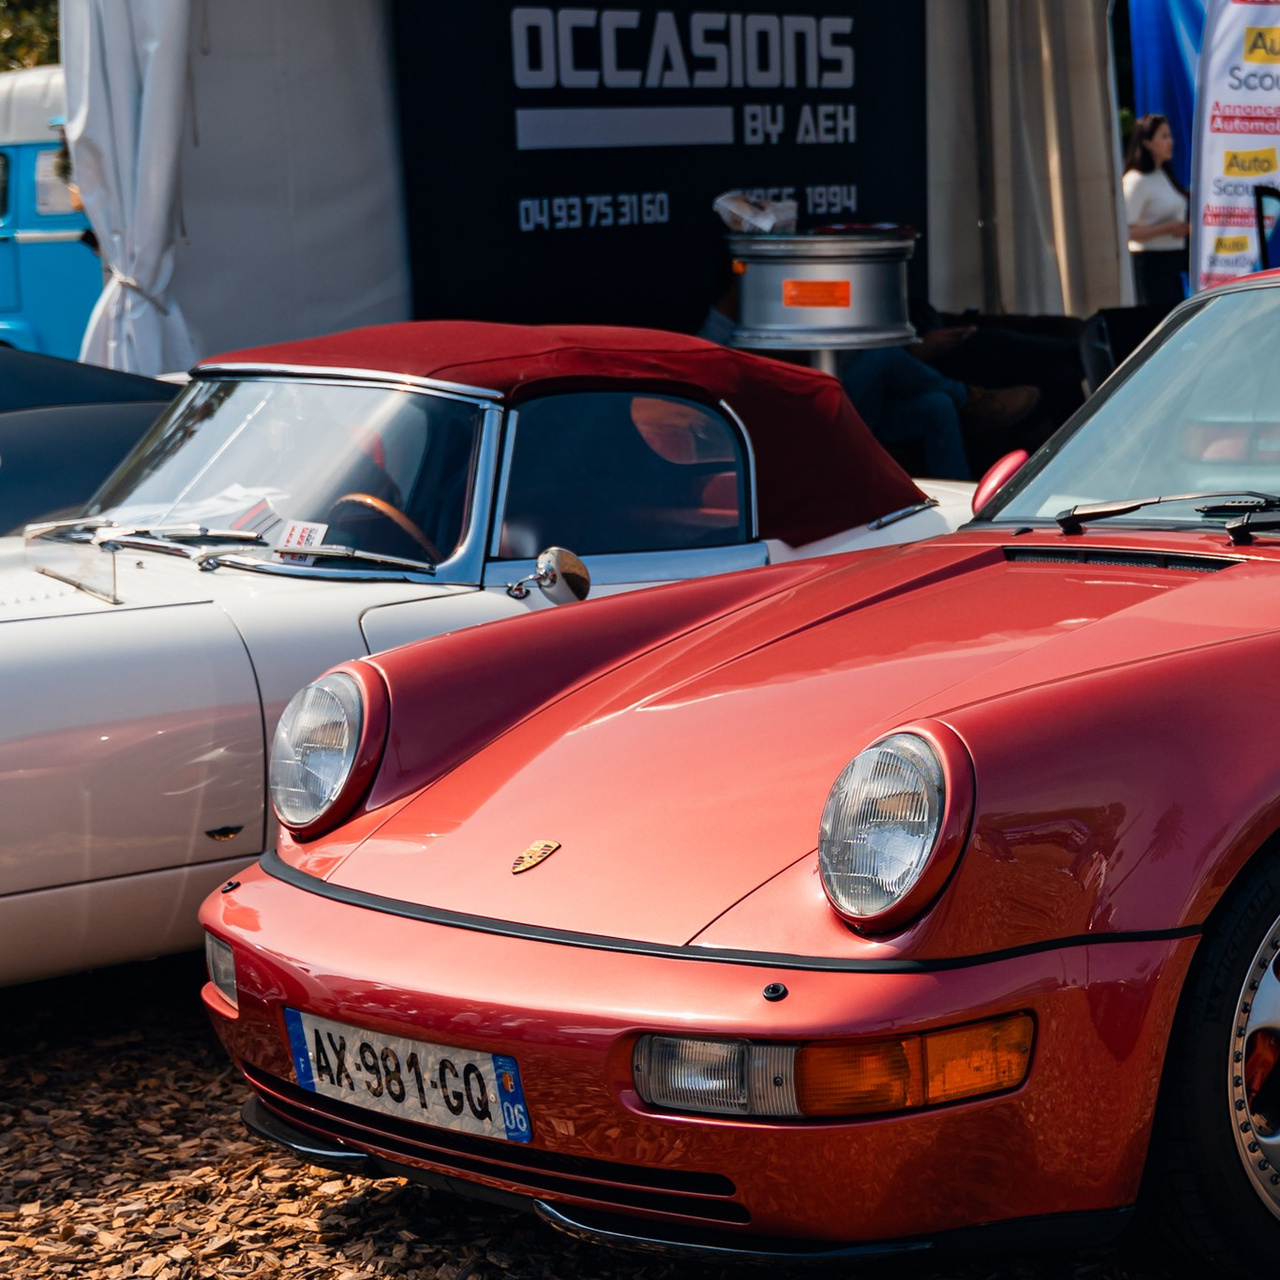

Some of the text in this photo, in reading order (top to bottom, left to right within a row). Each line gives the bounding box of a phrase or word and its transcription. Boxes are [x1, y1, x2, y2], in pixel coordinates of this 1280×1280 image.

[510, 7, 855, 89] OCCASIONS
[744, 104, 857, 146] BY AEH
[1226, 154, 1273, 173] Auto
[519, 192, 670, 232] 04 93 75 31 60
[805, 184, 858, 215] 1994
[314, 1029, 493, 1122] AX-981-GQ
[503, 1100, 528, 1132] 06
